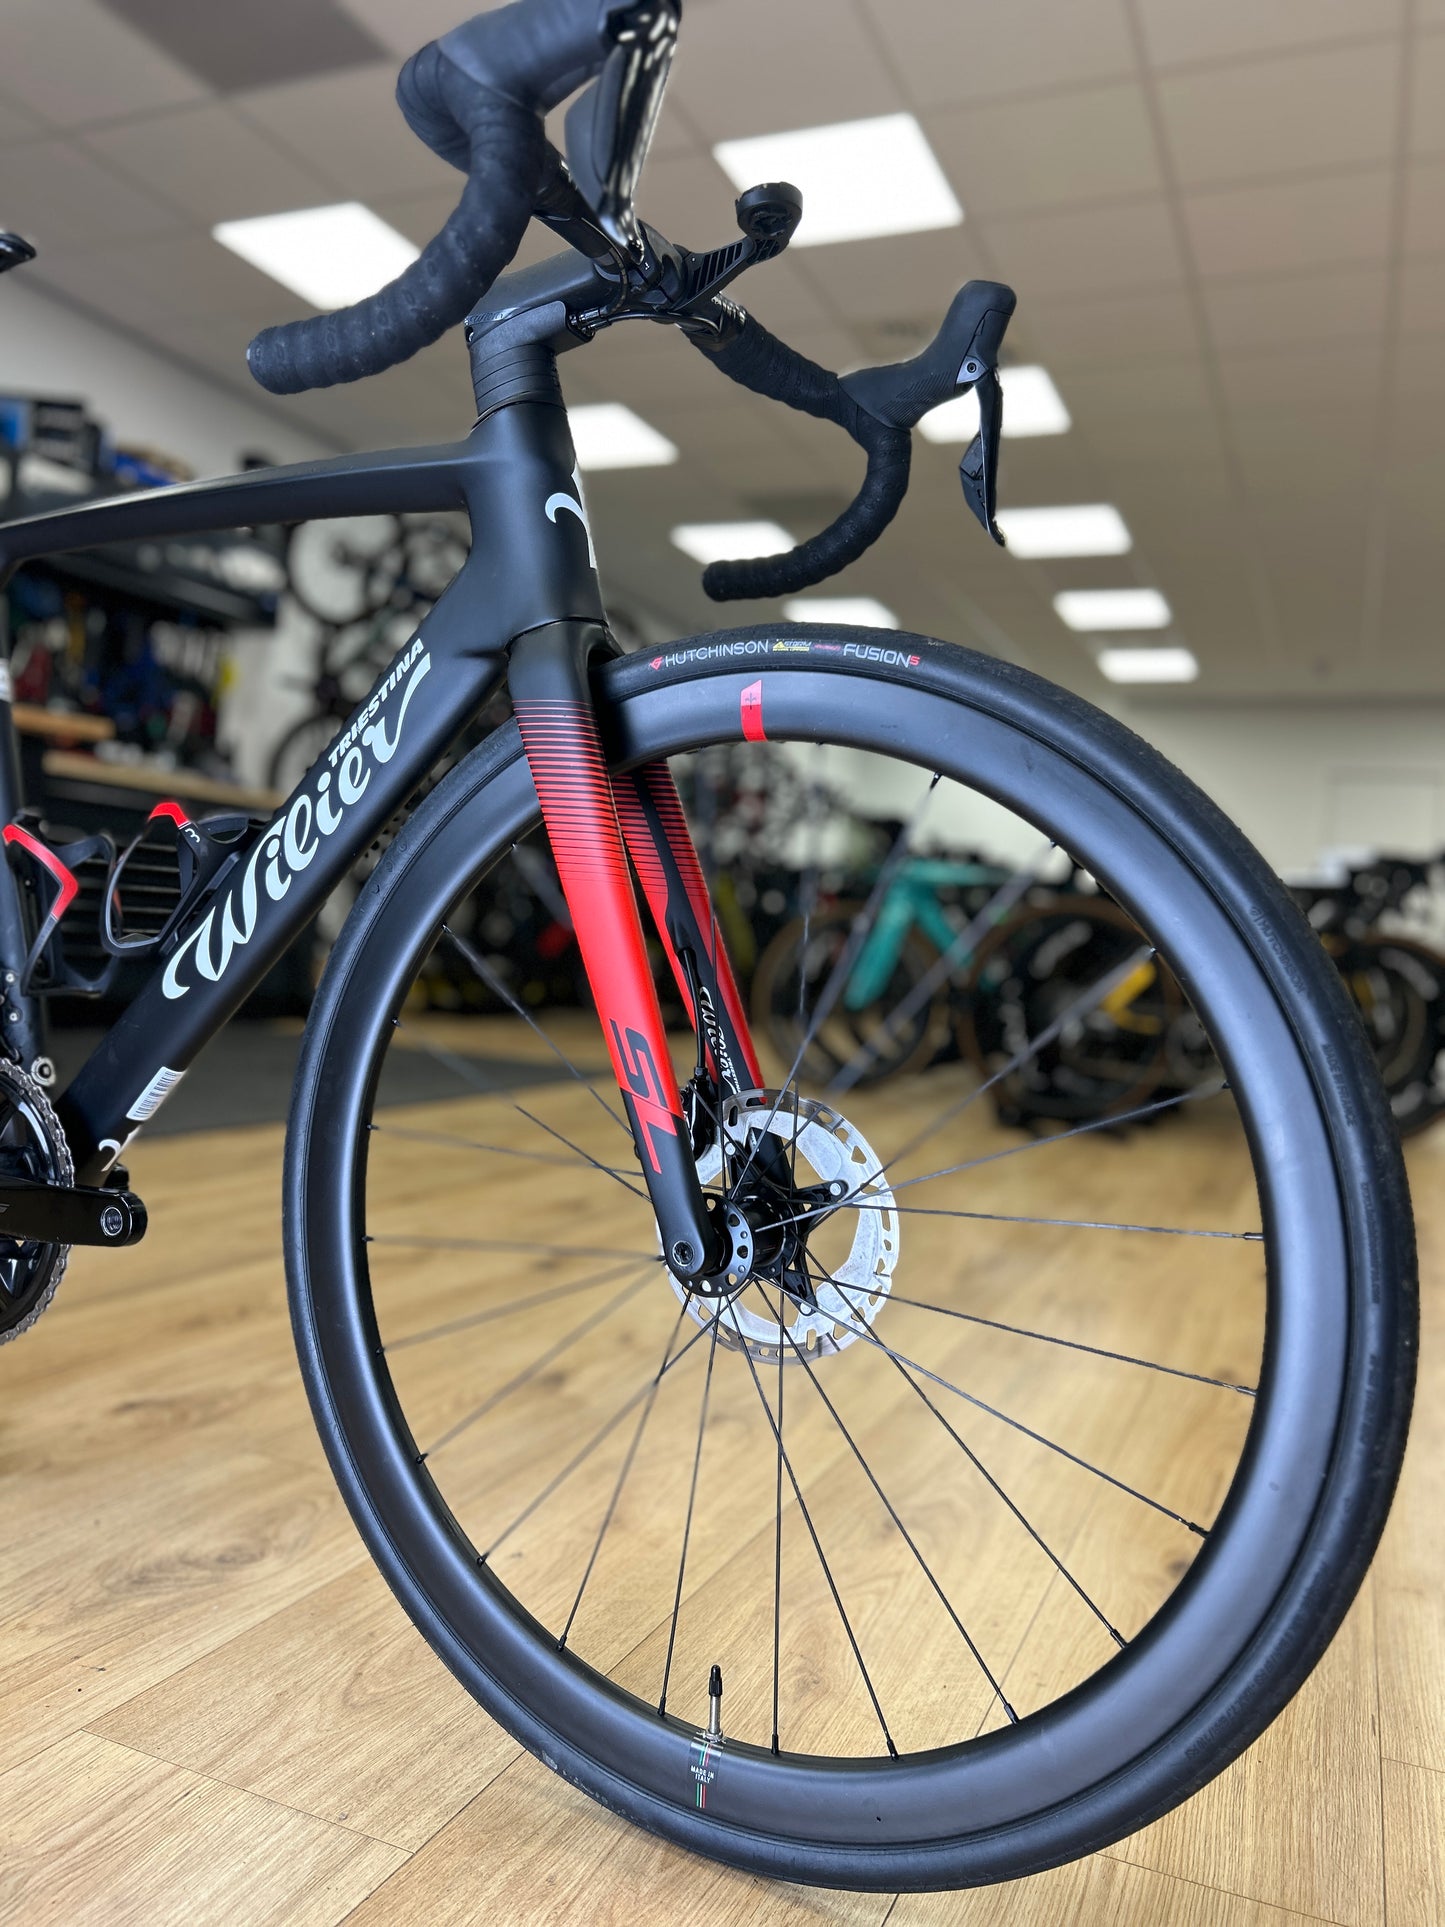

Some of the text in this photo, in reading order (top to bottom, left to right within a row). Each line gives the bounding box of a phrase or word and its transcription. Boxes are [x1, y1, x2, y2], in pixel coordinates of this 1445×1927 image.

[665, 640, 769, 667] HUTCHINSON
[328, 638, 425, 768] TRIESTINA
[162, 652, 431, 999] Wilier
[609, 1018, 677, 1174] SL
[690, 1765, 715, 1779] MADE IN
[695, 1773, 711, 1784] ITALY
